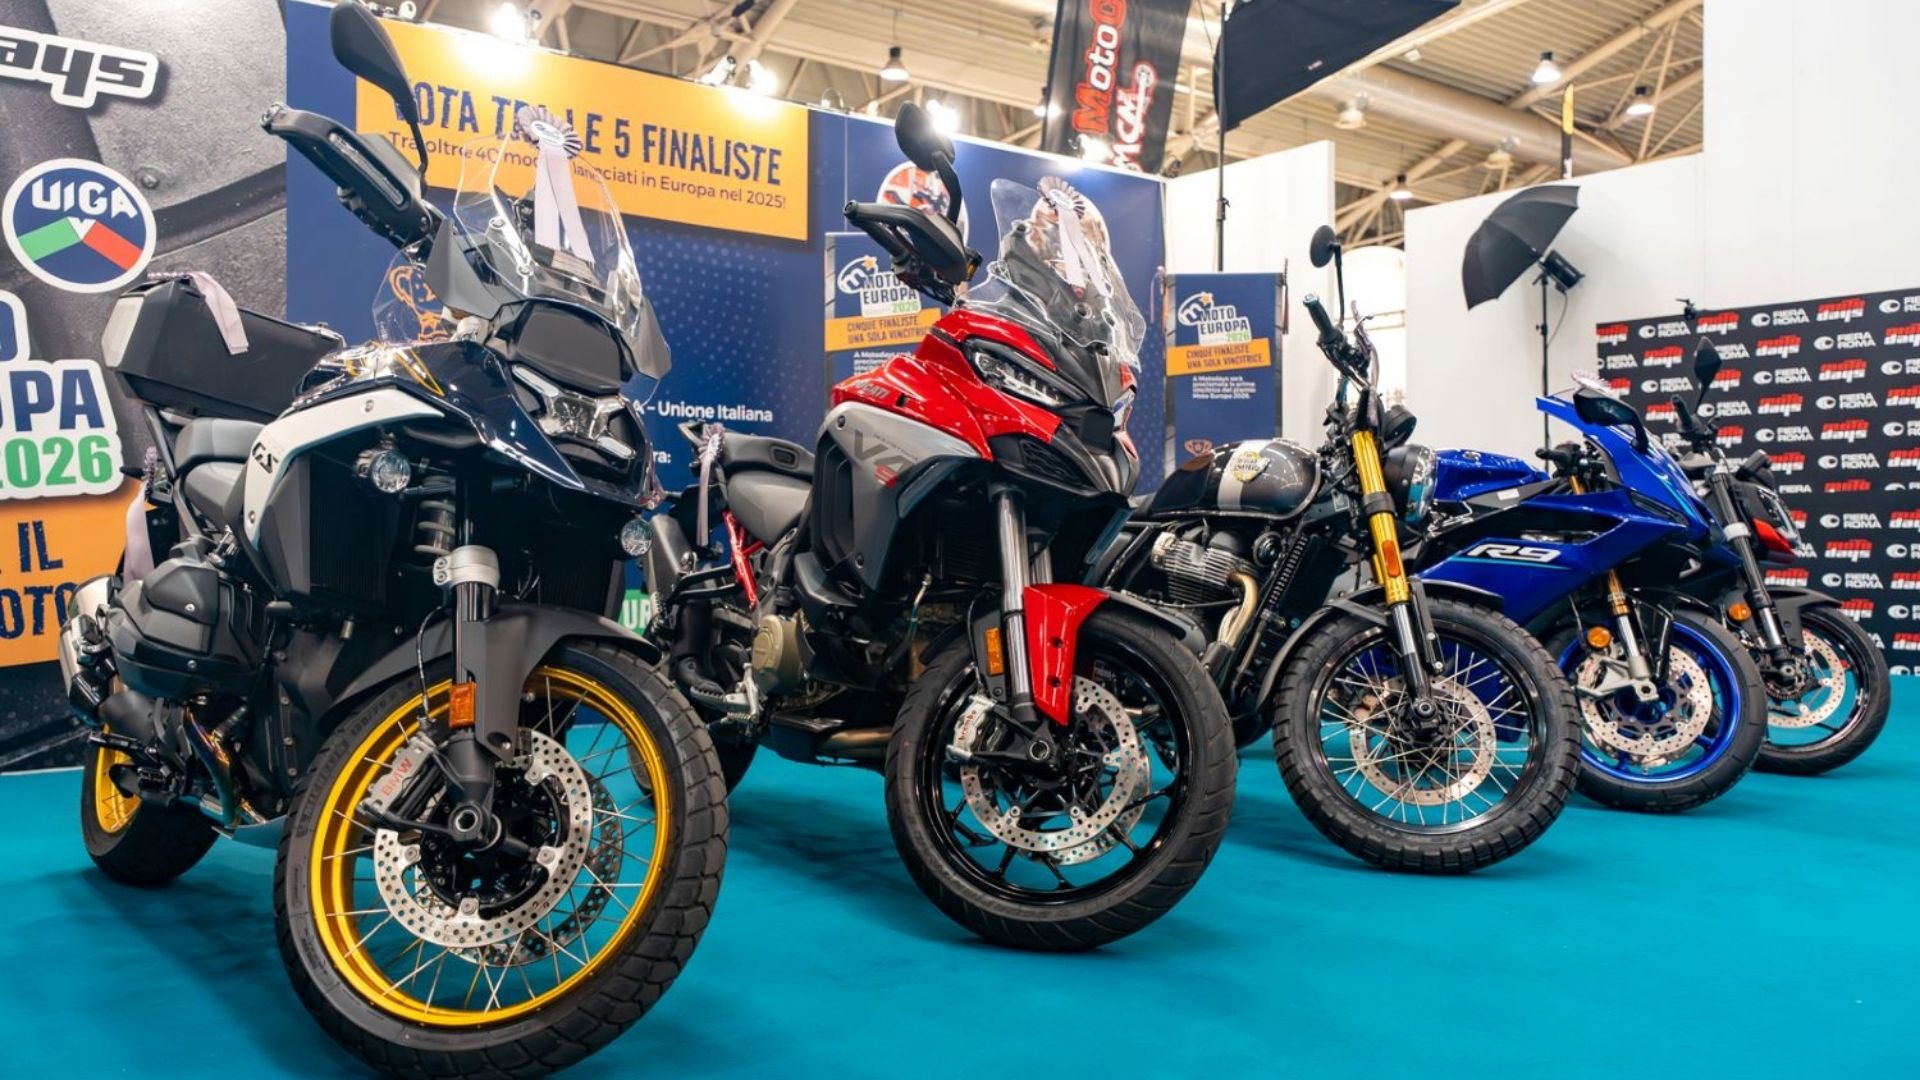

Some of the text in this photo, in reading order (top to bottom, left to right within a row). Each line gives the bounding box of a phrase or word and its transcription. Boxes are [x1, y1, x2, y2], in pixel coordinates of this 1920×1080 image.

[396, 82, 480, 133] OTA
[492, 95, 546, 149] TR
[614, 118, 630, 158] 5
[642, 124, 782, 186] FINALISTE
[31, 177, 138, 219] UIGA
[641, 173, 656, 188] in
[660, 176, 716, 198] Europa
[721, 188, 743, 202] nel
[747, 190, 787, 209] 2025!
[862, 288, 918, 305] EUROPA
[892, 300, 919, 314] 2026
[1200, 307, 1235, 322] MOTO
[879, 315, 917, 328] FINALISTE
[1816, 309, 1863, 323] days
[1200, 319, 1249, 335] EUROPA
[1696, 322, 1738, 335] days
[1225, 331, 1250, 343] 2026
[1756, 345, 1799, 359] days
[1643, 355, 1682, 369] days
[1818, 369, 1865, 384] days
[0, 369, 105, 432] PA
[657, 401, 714, 419] Unione
[717, 405, 774, 423] Italiana
[1758, 403, 1801, 417] days
[1820, 429, 1867, 443] days
[0, 435, 113, 489] 026
[252, 442, 279, 474] GS
[1779, 484, 1812, 493] FIERA
[18, 520, 64, 572] IL
[1467, 544, 1560, 563] R9
[1824, 549, 1871, 563] days
[1764, 576, 1808, 588] days
[381, 757, 413, 797] BMW
